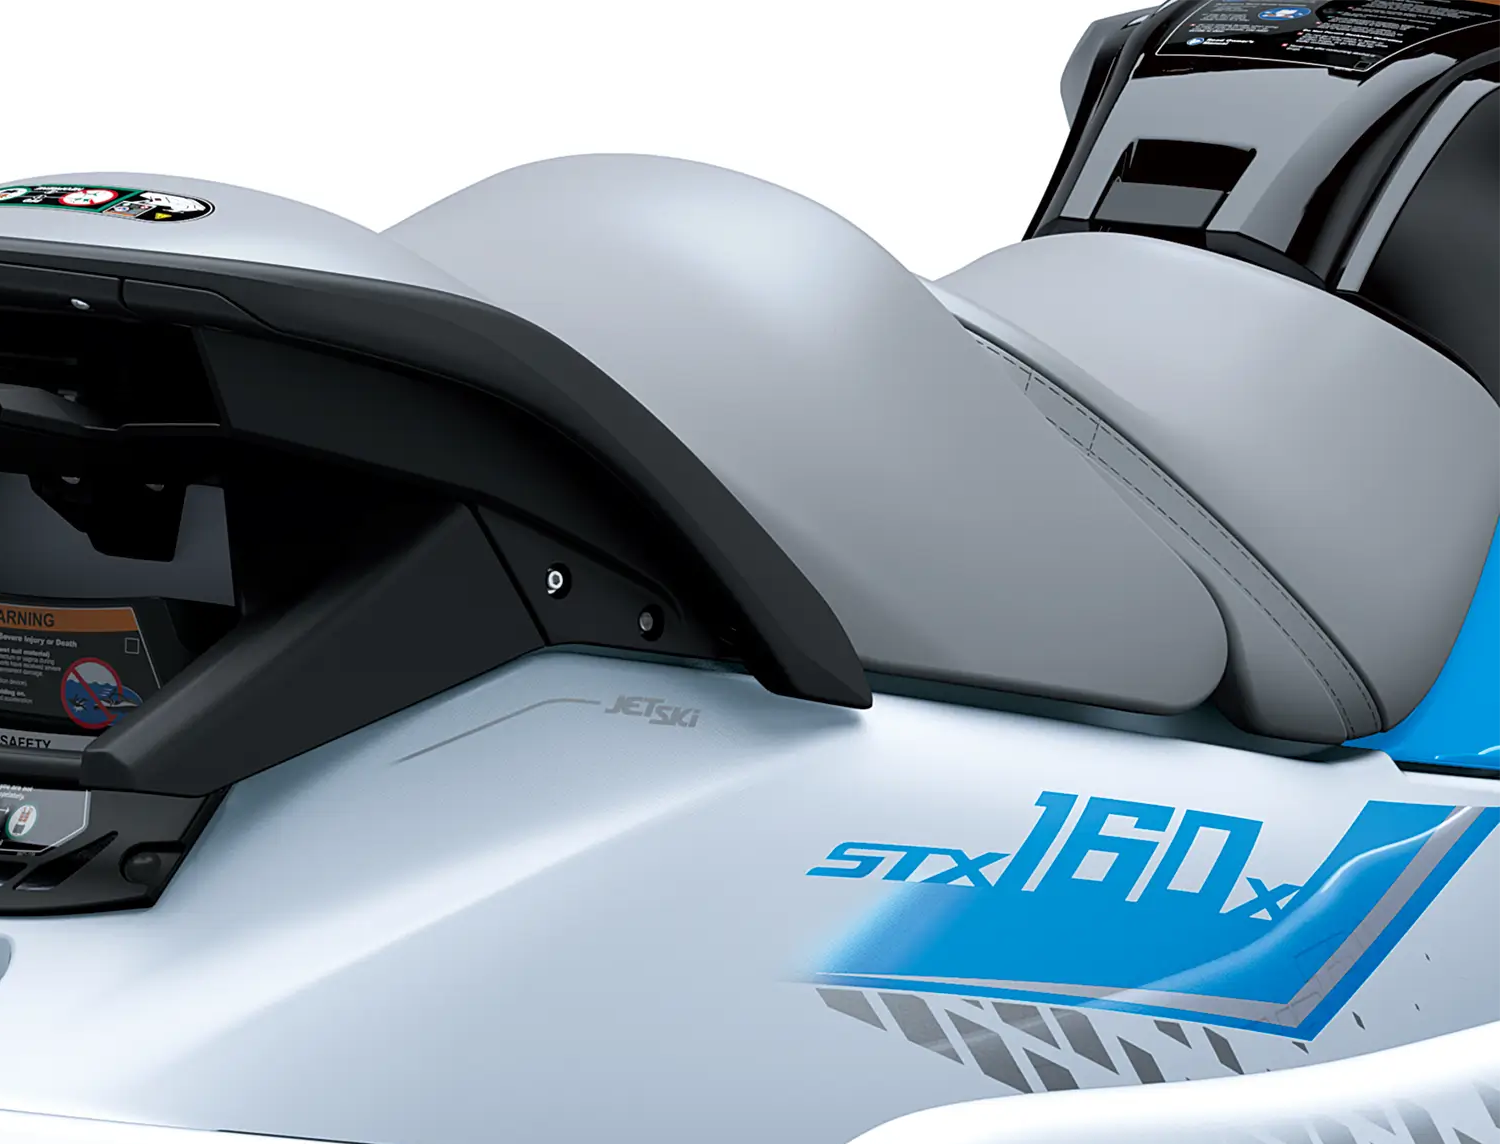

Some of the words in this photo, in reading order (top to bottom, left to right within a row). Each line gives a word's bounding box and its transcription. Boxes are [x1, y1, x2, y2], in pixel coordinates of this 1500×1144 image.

[23, 635, 45, 646] Injury
[55, 638, 78, 649] Death
[0, 735, 51, 749] SAFETY
[806, 842, 1012, 889] STX
